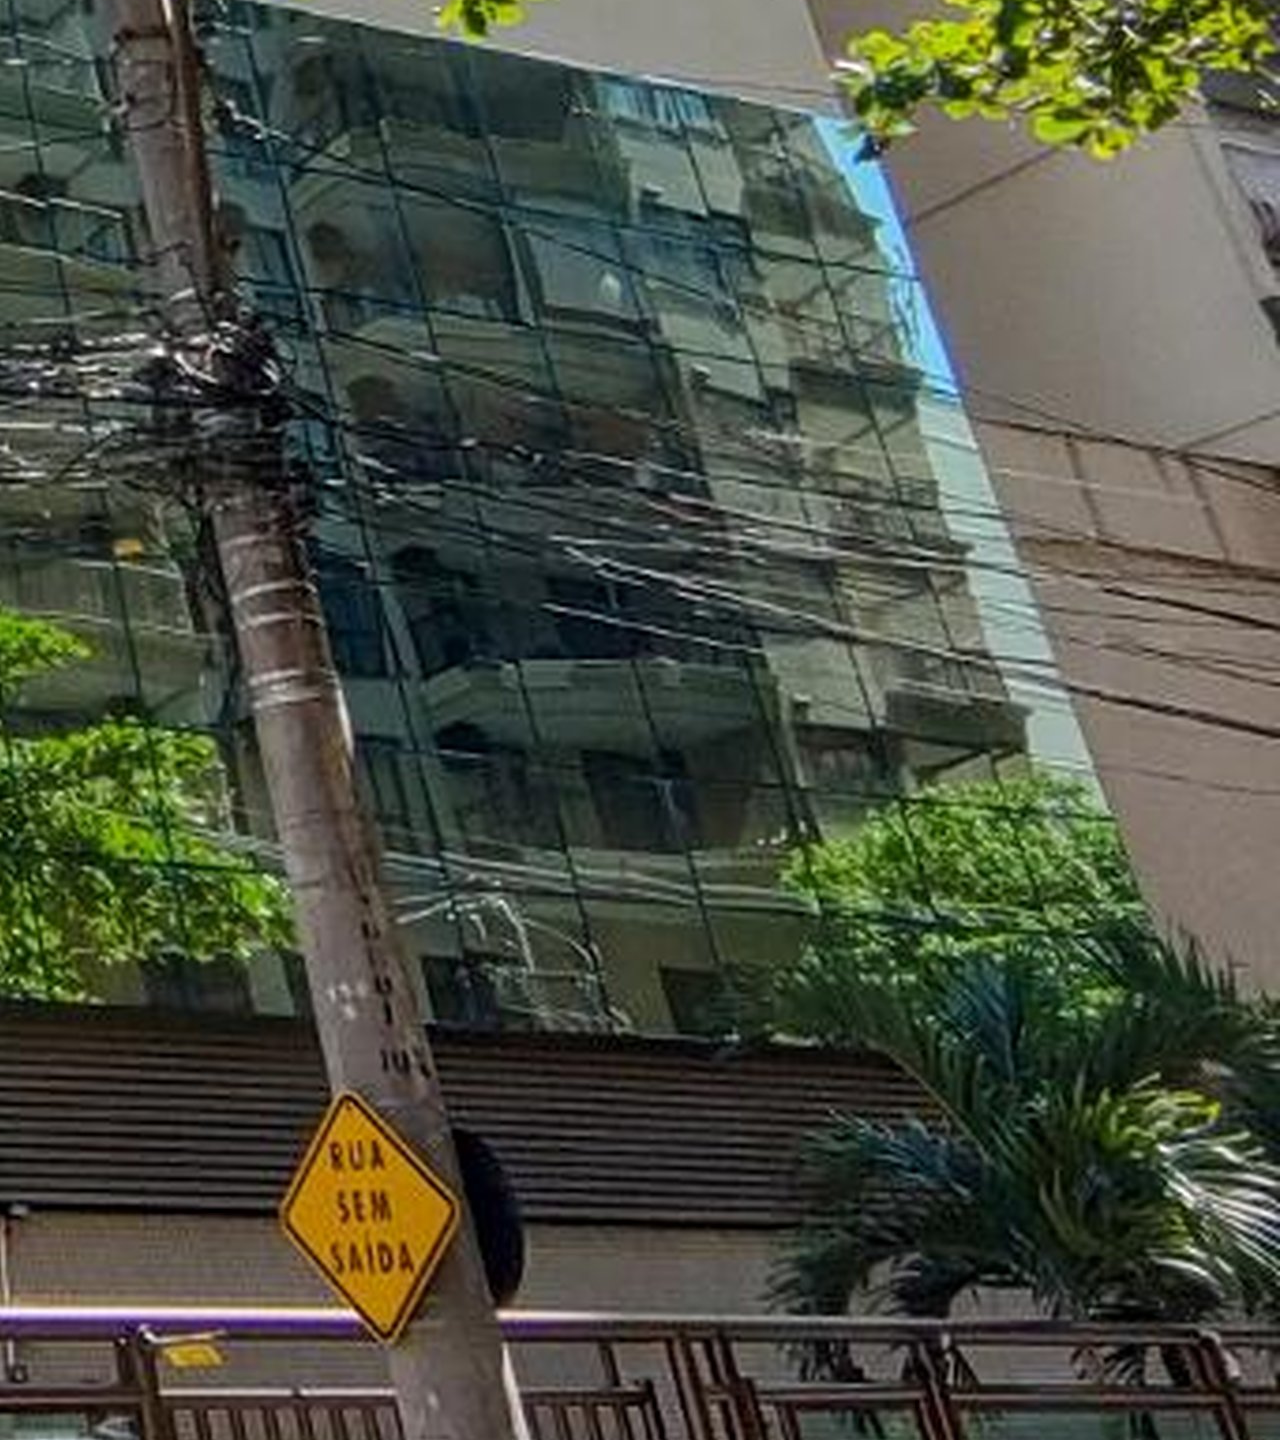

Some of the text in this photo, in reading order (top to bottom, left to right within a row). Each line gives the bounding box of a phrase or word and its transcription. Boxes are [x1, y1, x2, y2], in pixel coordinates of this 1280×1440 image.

[329, 1140, 387, 1170] RUA
[336, 1190, 392, 1222] SEM
[330, 1233, 415, 1274] SAÍDA
